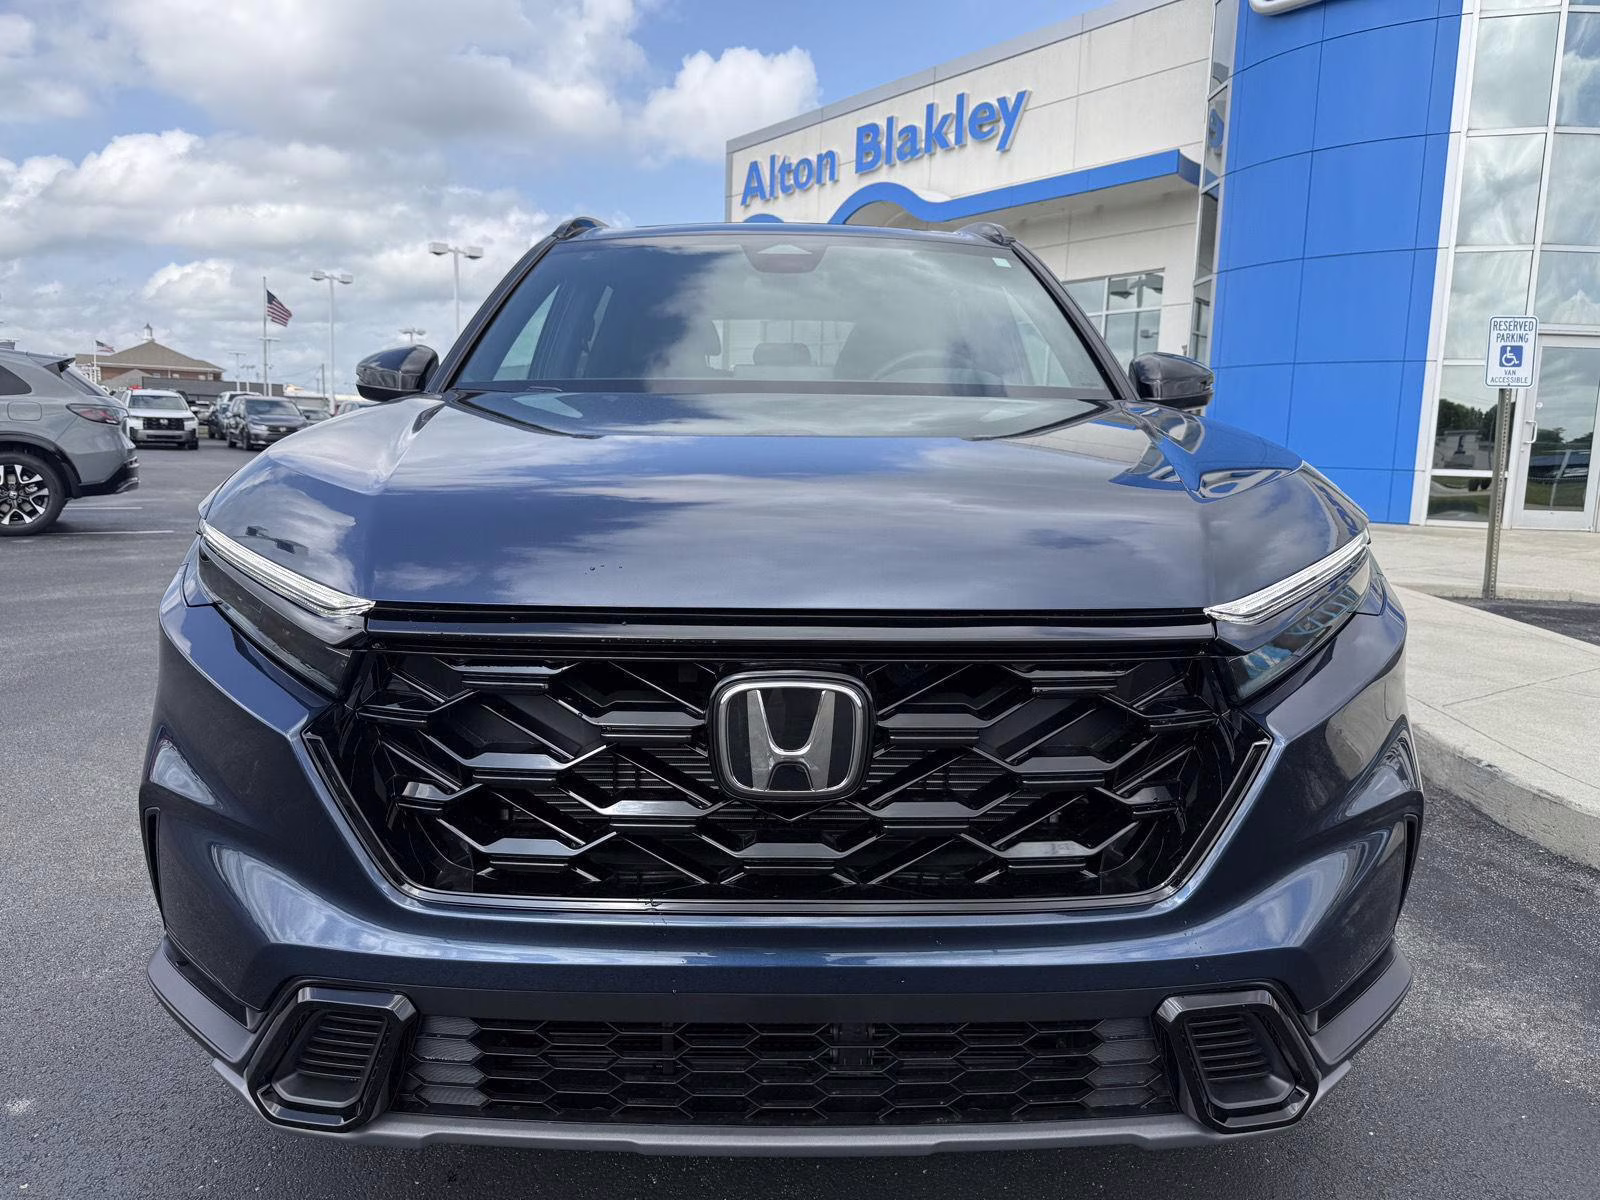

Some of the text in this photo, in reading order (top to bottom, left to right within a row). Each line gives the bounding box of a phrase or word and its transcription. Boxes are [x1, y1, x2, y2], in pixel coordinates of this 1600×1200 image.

[741, 89, 1031, 206] Alton Blakley
[1493, 320, 1534, 332] RESERVED
[1496, 332, 1529, 343] PARKING
[1490, 376, 1528, 384] ACCESSIBLE
